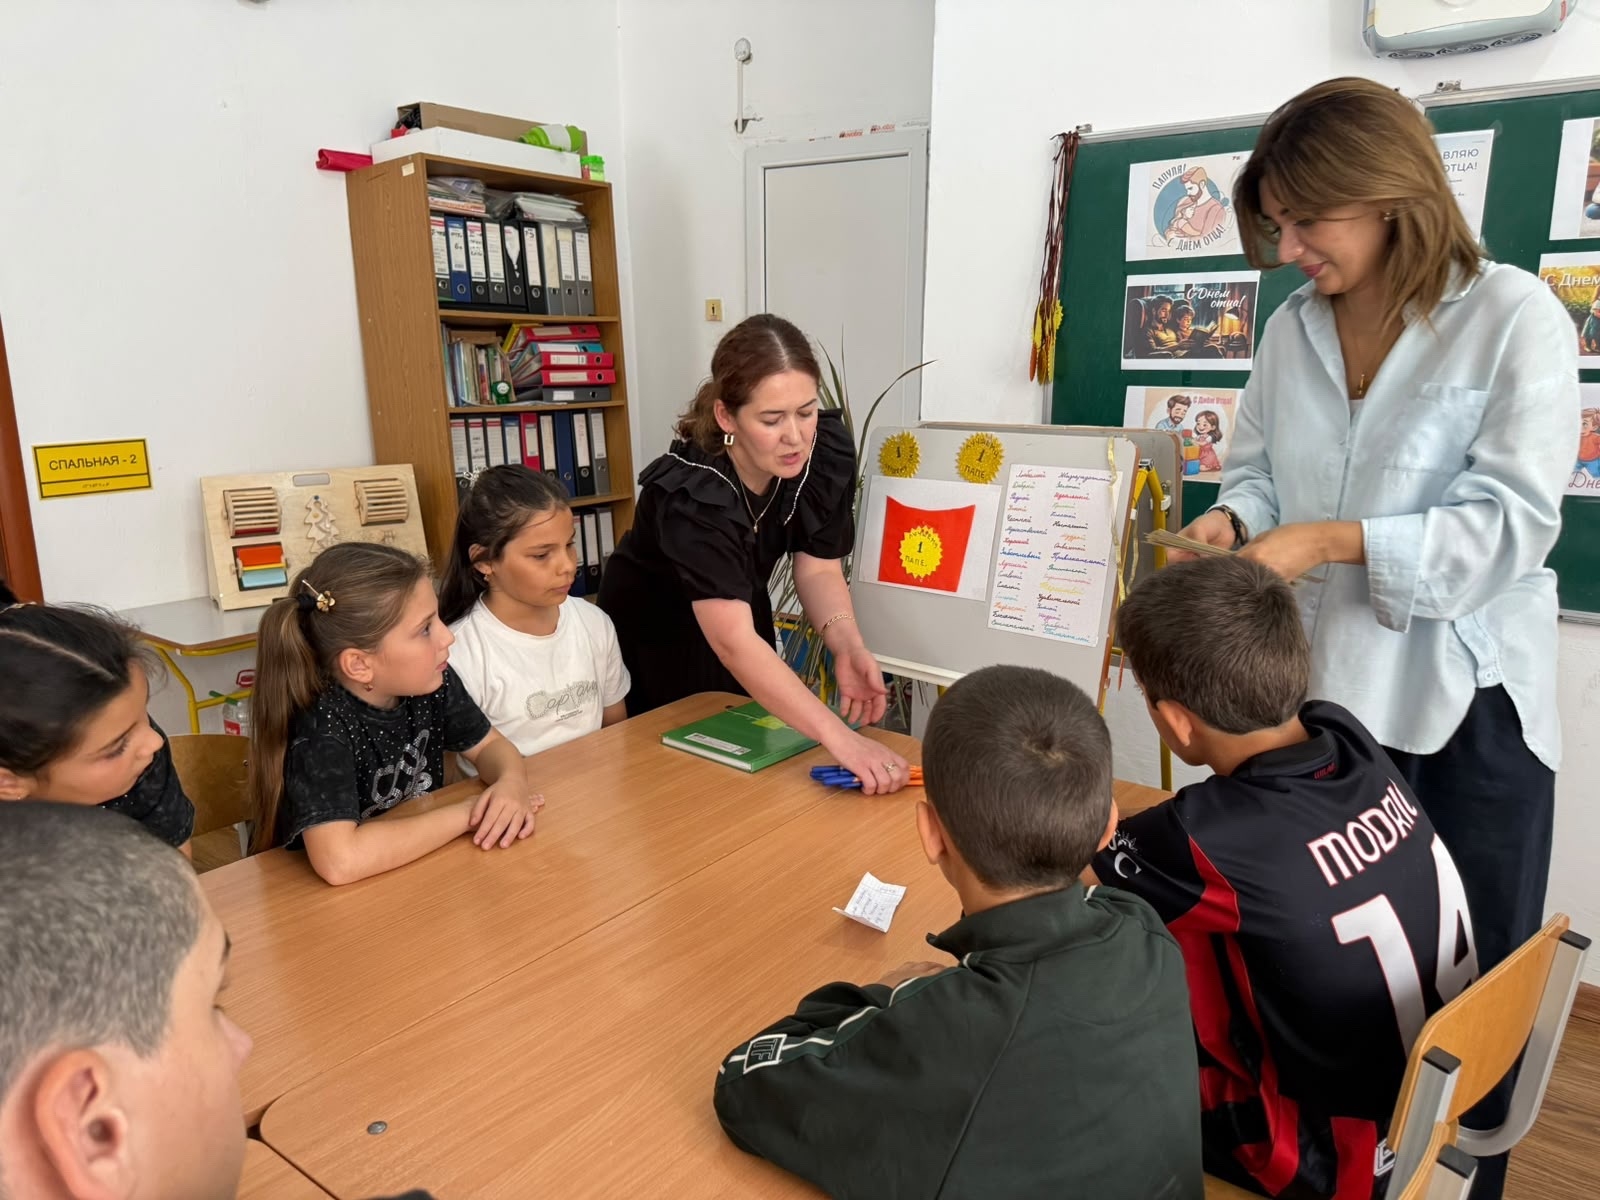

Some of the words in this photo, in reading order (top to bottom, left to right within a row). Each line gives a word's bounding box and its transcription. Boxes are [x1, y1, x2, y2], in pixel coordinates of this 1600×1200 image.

[1443, 148, 1479, 160] ВЛЯЮ
[1152, 163, 1187, 190] ПАПУЛЯ!
[1203, 223, 1227, 246] ОТЦА!
[1186, 287, 1196, 300] С
[1198, 287, 1231, 300] Днем
[1210, 295, 1247, 308] отца!
[49, 455, 120, 471] СПАЛЬНАЯ
[129, 454, 138, 464] 2
[976, 449, 985, 463] 1
[964, 464, 985, 479] ПАПЕ
[917, 541, 923, 554] 1
